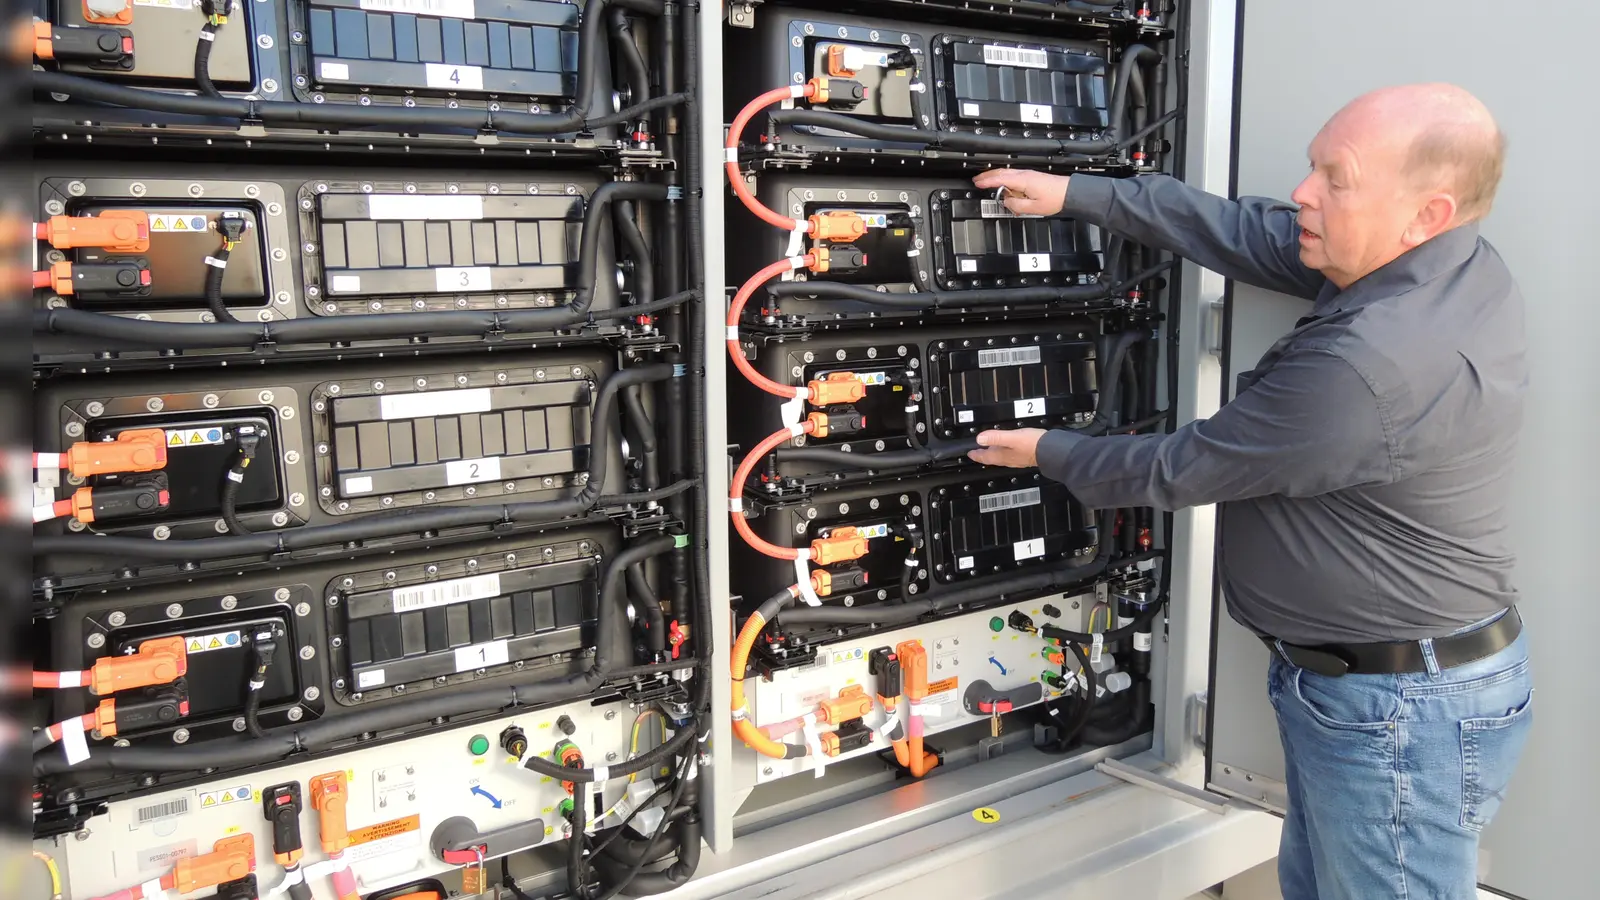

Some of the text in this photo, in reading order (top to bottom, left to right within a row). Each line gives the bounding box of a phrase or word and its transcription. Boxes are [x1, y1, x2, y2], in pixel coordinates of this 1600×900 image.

[449, 69, 460, 85] 4
[1032, 108, 1041, 120] 4
[1030, 256, 1039, 269] 3
[459, 271, 469, 287] 3
[1026, 401, 1035, 414] 2
[469, 463, 480, 479] 2
[1026, 543, 1033, 555] 1
[478, 647, 486, 662] 1
[468, 777, 480, 785] ON
[503, 799, 516, 807] OFF
[981, 809, 994, 820] 4
[362, 821, 411, 838] AVERTISSEMENT
[372, 819, 401, 830] WARNING
[369, 828, 406, 841] ATTENZIONE
